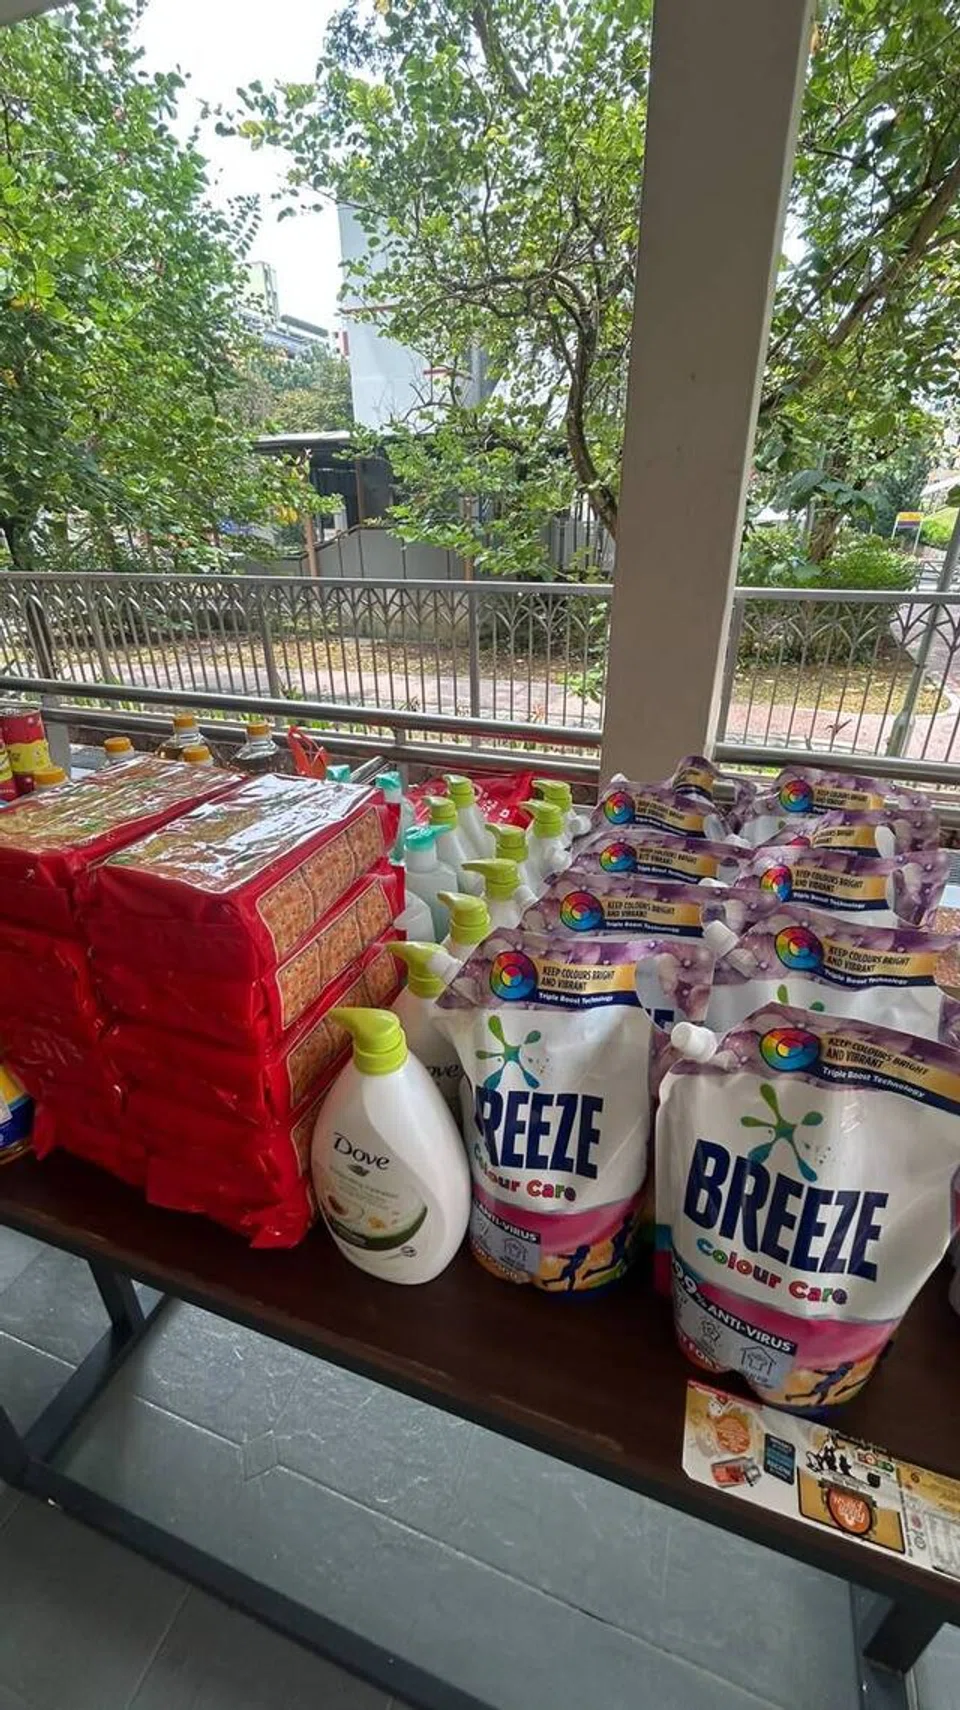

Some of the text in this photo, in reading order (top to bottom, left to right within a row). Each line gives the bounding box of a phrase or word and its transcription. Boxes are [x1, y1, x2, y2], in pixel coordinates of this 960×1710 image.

[794, 879, 835, 892] AND VIBRANT
[796, 870, 864, 889] KEEP COLOURS BRIGHT
[606, 910, 648, 918] AND VIBRANT
[624, 902, 650, 911] COLOURS
[652, 904, 675, 915] BRIGHT
[827, 956, 876, 972] AND VIBRANT
[829, 946, 911, 966] KEEP COLOURS BRIGHT
[542, 966, 616, 980] KEEP COLOURS BRIGHT
[540, 976, 588, 992] AND VIBRANT
[538, 992, 614, 1005] Triple Boost Technology
[826, 1048, 884, 1069] AND VIBRANT
[828, 1038, 930, 1076] KEEP COLOURS BRIGHT
[425, 1064, 460, 1078] ove
[822, 1066, 926, 1098] Triple Boost Technology
[475, 1086, 604, 1180] REEZE
[333, 1131, 390, 1171] Dove
[526, 1179, 577, 1203] Care
[684, 1138, 889, 1283] BREEZE
[696, 1236, 848, 1306] Colour Care
[707, 1305, 795, 1353] ANTI-VIRUS
